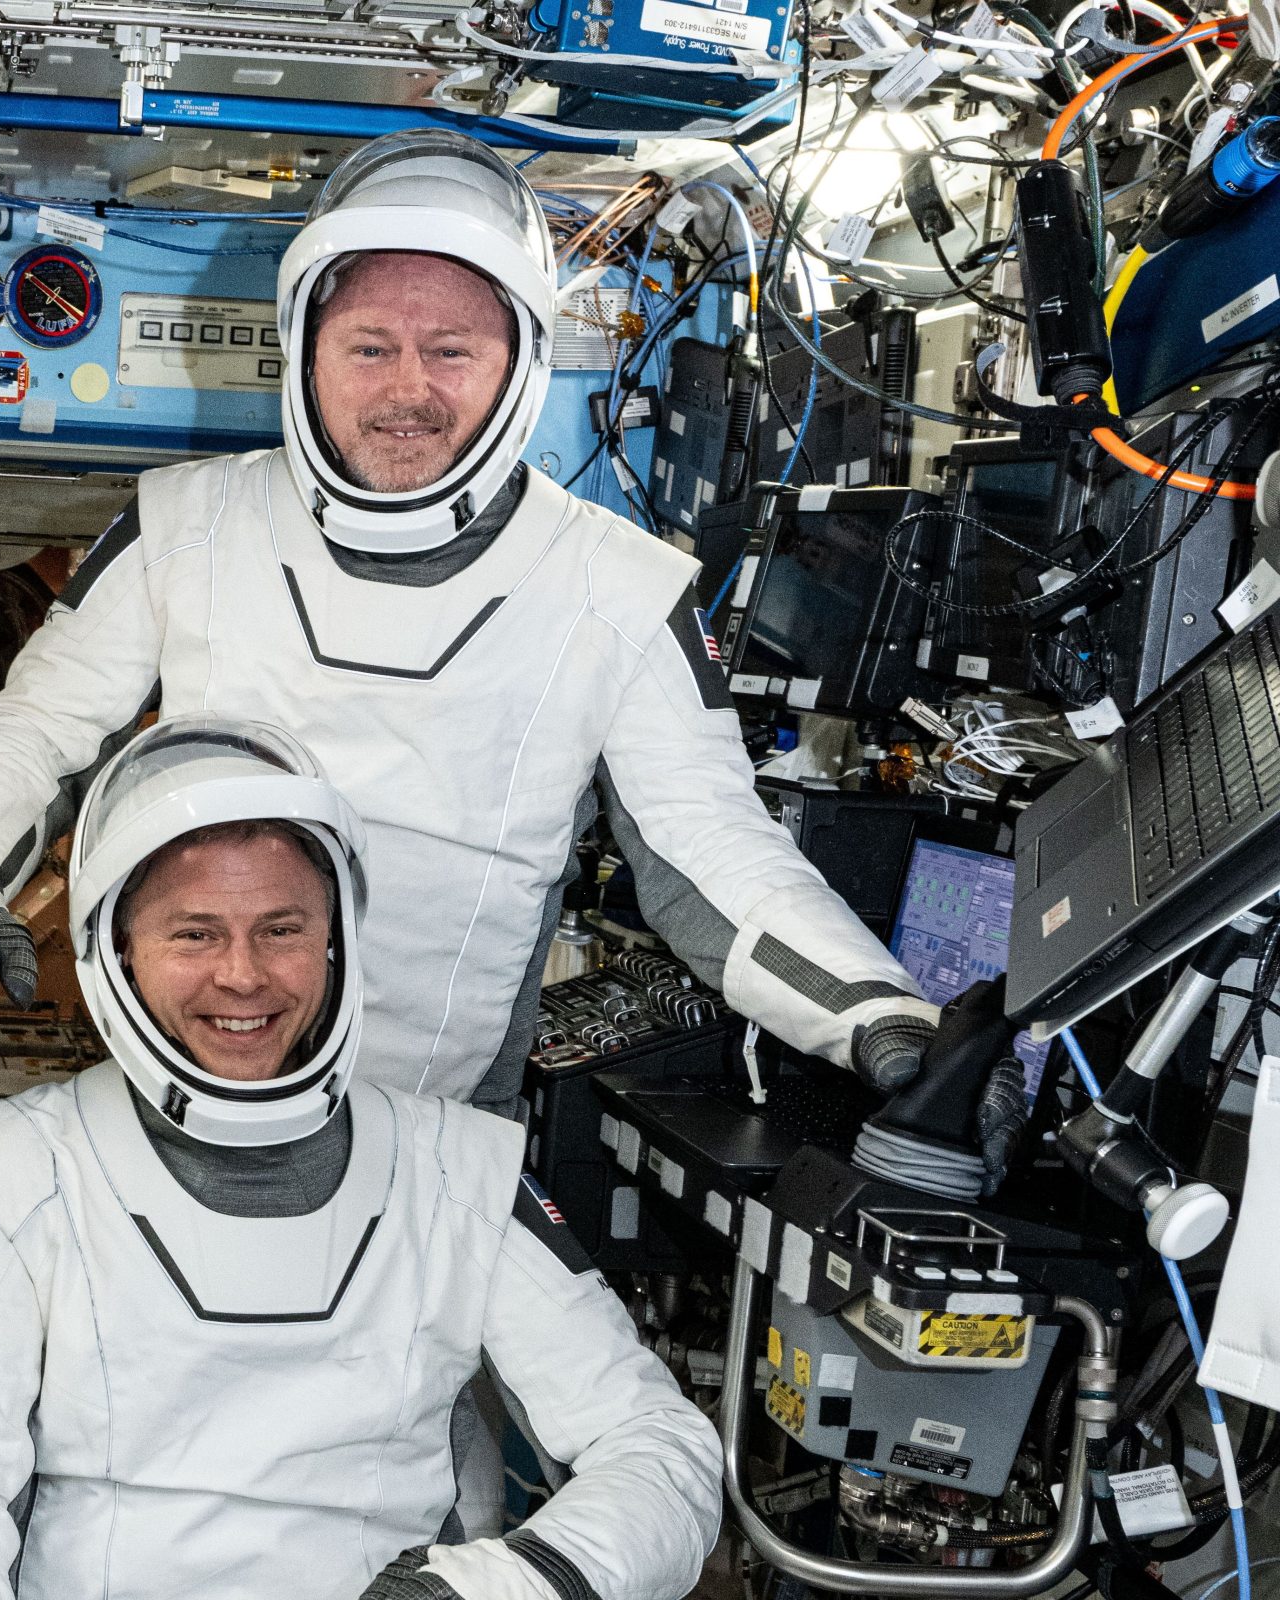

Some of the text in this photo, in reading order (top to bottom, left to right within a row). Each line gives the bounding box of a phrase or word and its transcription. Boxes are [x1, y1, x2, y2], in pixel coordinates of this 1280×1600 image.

[663, 34, 686, 49] Supply
[689, 41, 710, 53] Power
[1230, 293, 1260, 318] INVERTER
[942, 1321, 978, 1329] CAUTION
